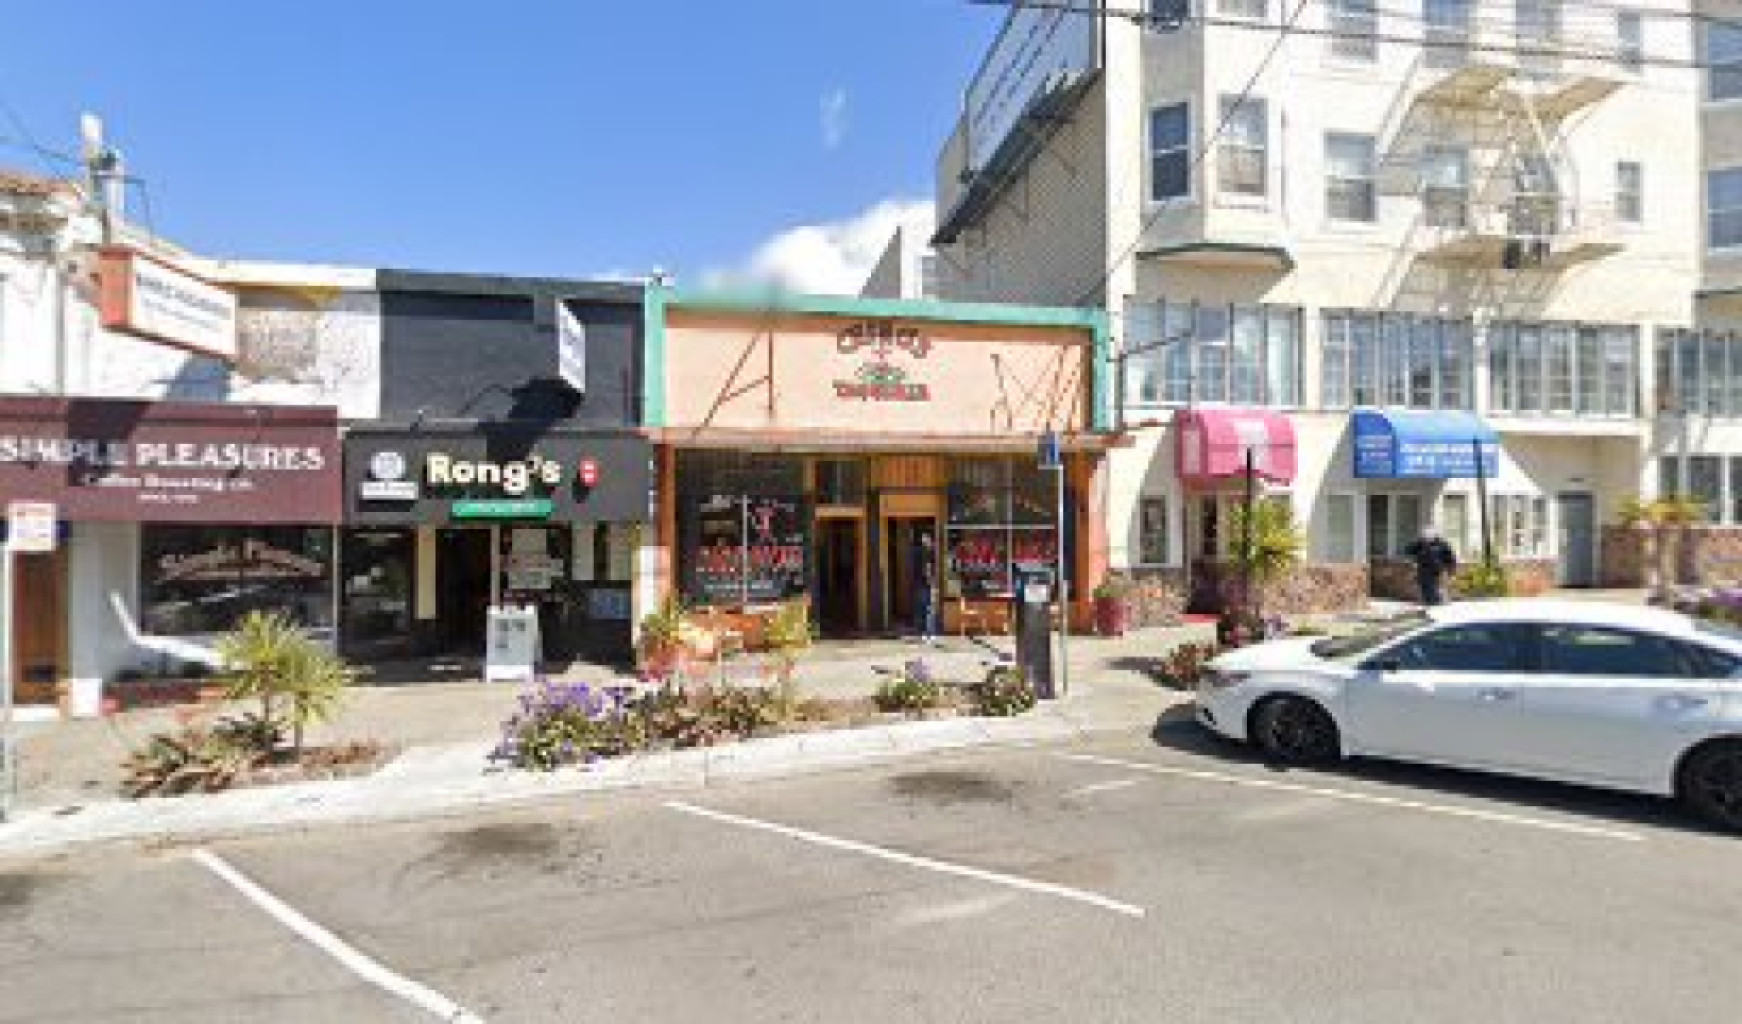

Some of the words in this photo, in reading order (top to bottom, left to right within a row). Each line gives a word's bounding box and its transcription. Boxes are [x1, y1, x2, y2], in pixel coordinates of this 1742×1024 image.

[0, 437, 127, 465] SIMPLE
[136, 443, 325, 469] PLEASURES
[427, 452, 562, 495] Rong's
